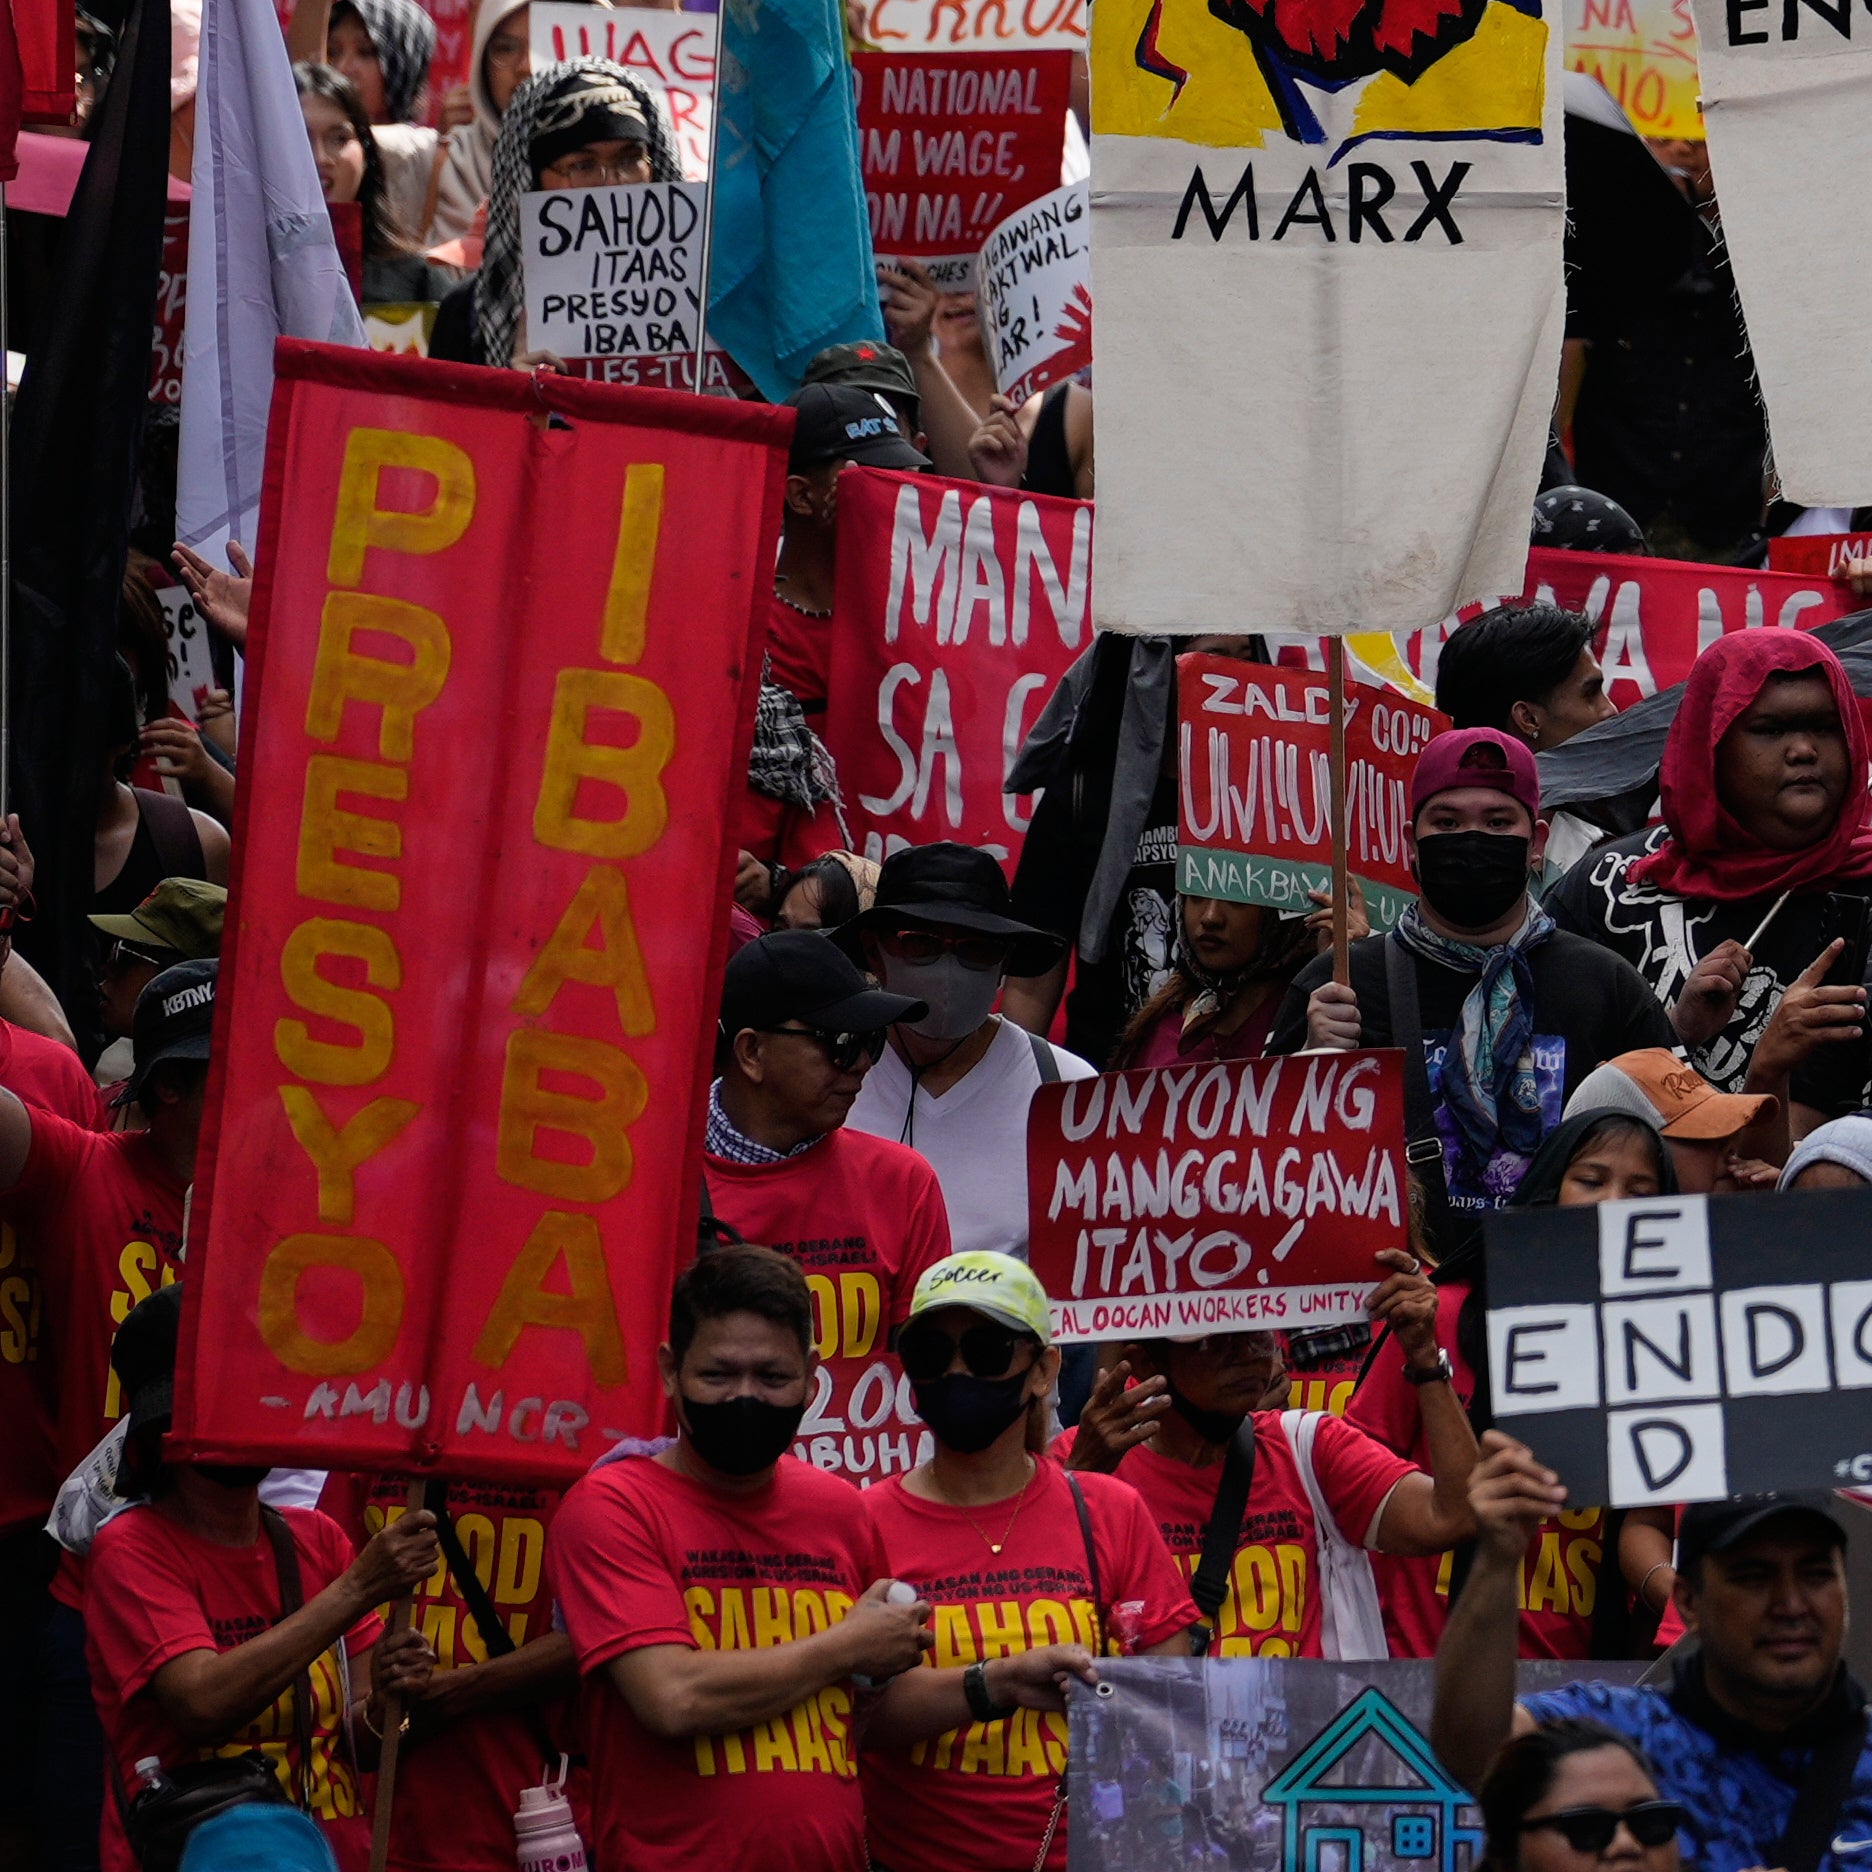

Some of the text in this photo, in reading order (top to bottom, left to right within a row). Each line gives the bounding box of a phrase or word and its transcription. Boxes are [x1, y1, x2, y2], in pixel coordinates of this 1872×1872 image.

[881, 68, 1042, 116] NATIONAL
[914, 129, 1025, 183] WAGE,
[538, 185, 699, 257] SAHOD
[914, 192, 1004, 243] NA!!
[1171, 159, 1475, 247] MARX
[591, 246, 687, 289] ITAAS
[542, 288, 677, 324] PRESYO
[584, 320, 691, 355] IBABA
[858, 661, 964, 828] SA
[258, 426, 478, 1378] PRESYO
[471, 462, 676, 1390] IBABA
[1060, 1057, 1283, 1143] UNYON
[1288, 1057, 1381, 1133] NG
[1047, 1146, 1402, 1228] MANGGAGAWA
[928, 1264, 1004, 1291] Soccer
[1070, 1219, 1305, 1298] ITAYO!
[1178, 1292, 1287, 1333] WORKERS
[1298, 1289, 1365, 1315] UNITY
[304, 1378, 589, 1449] KMU NCR
